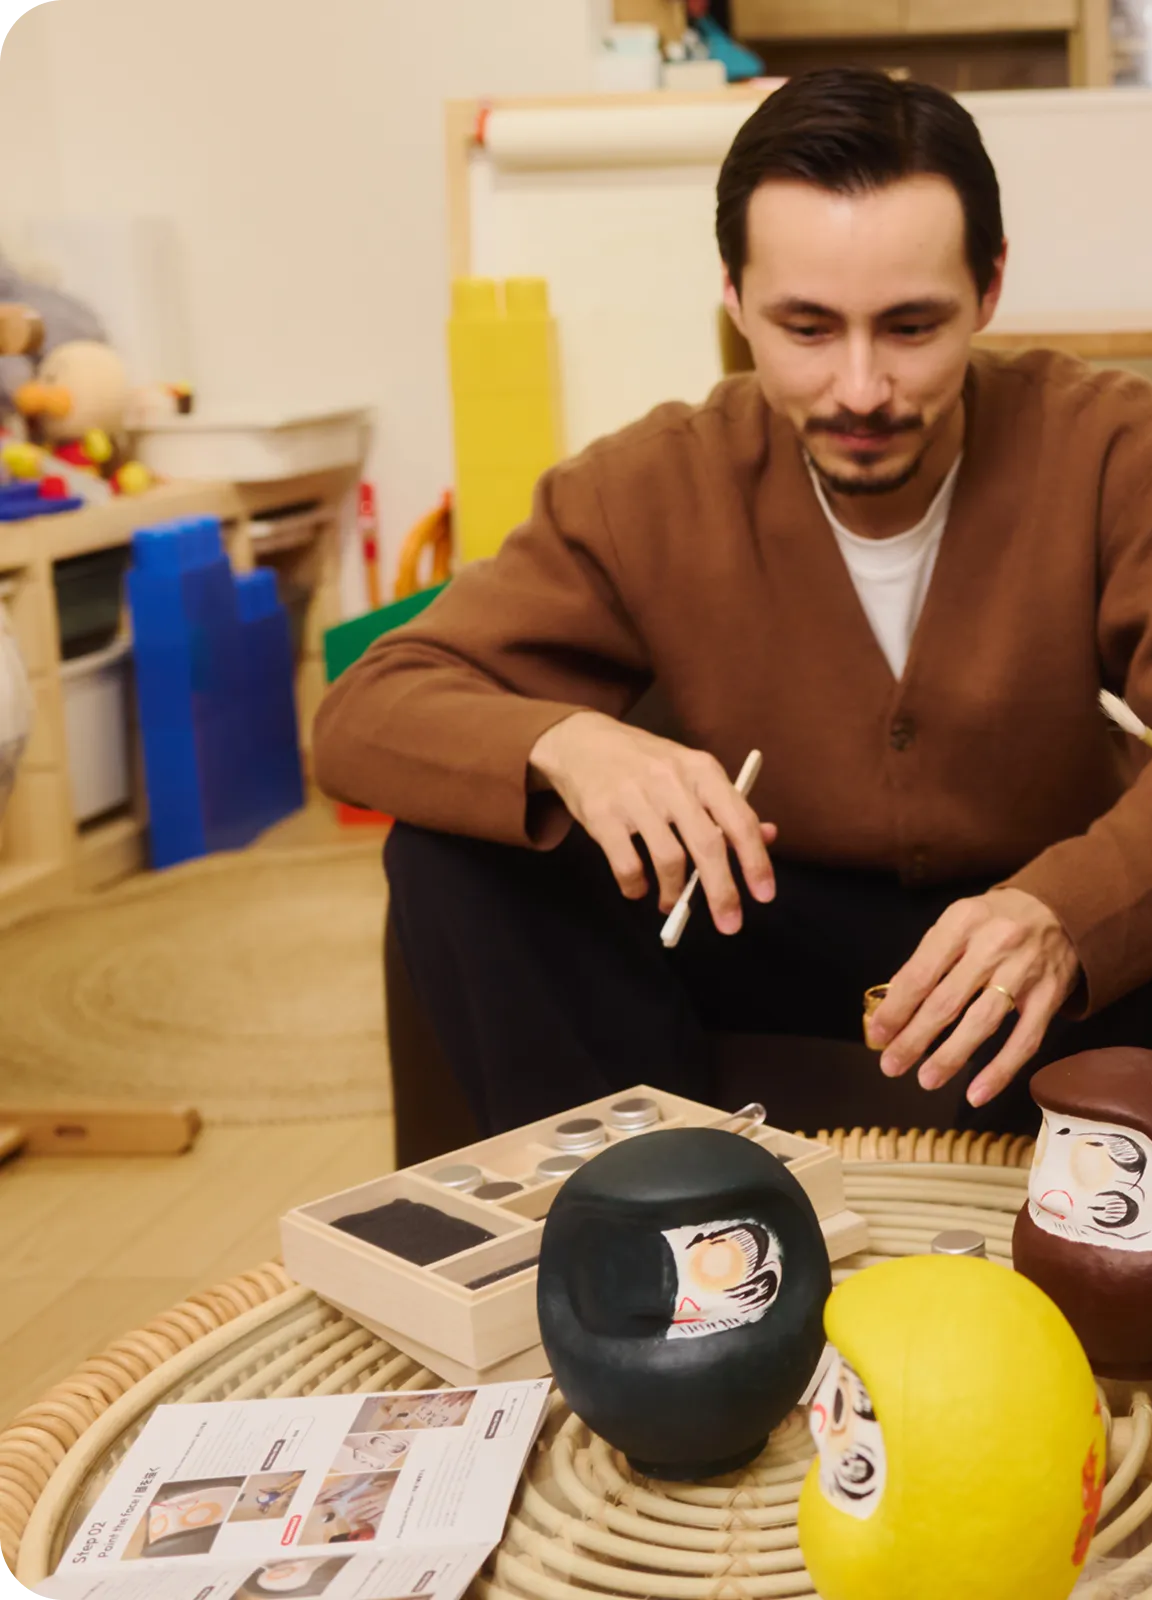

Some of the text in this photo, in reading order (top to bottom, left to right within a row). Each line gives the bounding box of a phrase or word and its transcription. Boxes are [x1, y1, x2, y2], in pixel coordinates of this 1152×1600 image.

[120, 1499, 139, 1516] face
[112, 1518, 129, 1531] the
[72, 1538, 98, 1563] Step
[88, 1521, 107, 1536] 02
[98, 1534, 119, 1557] Paint
